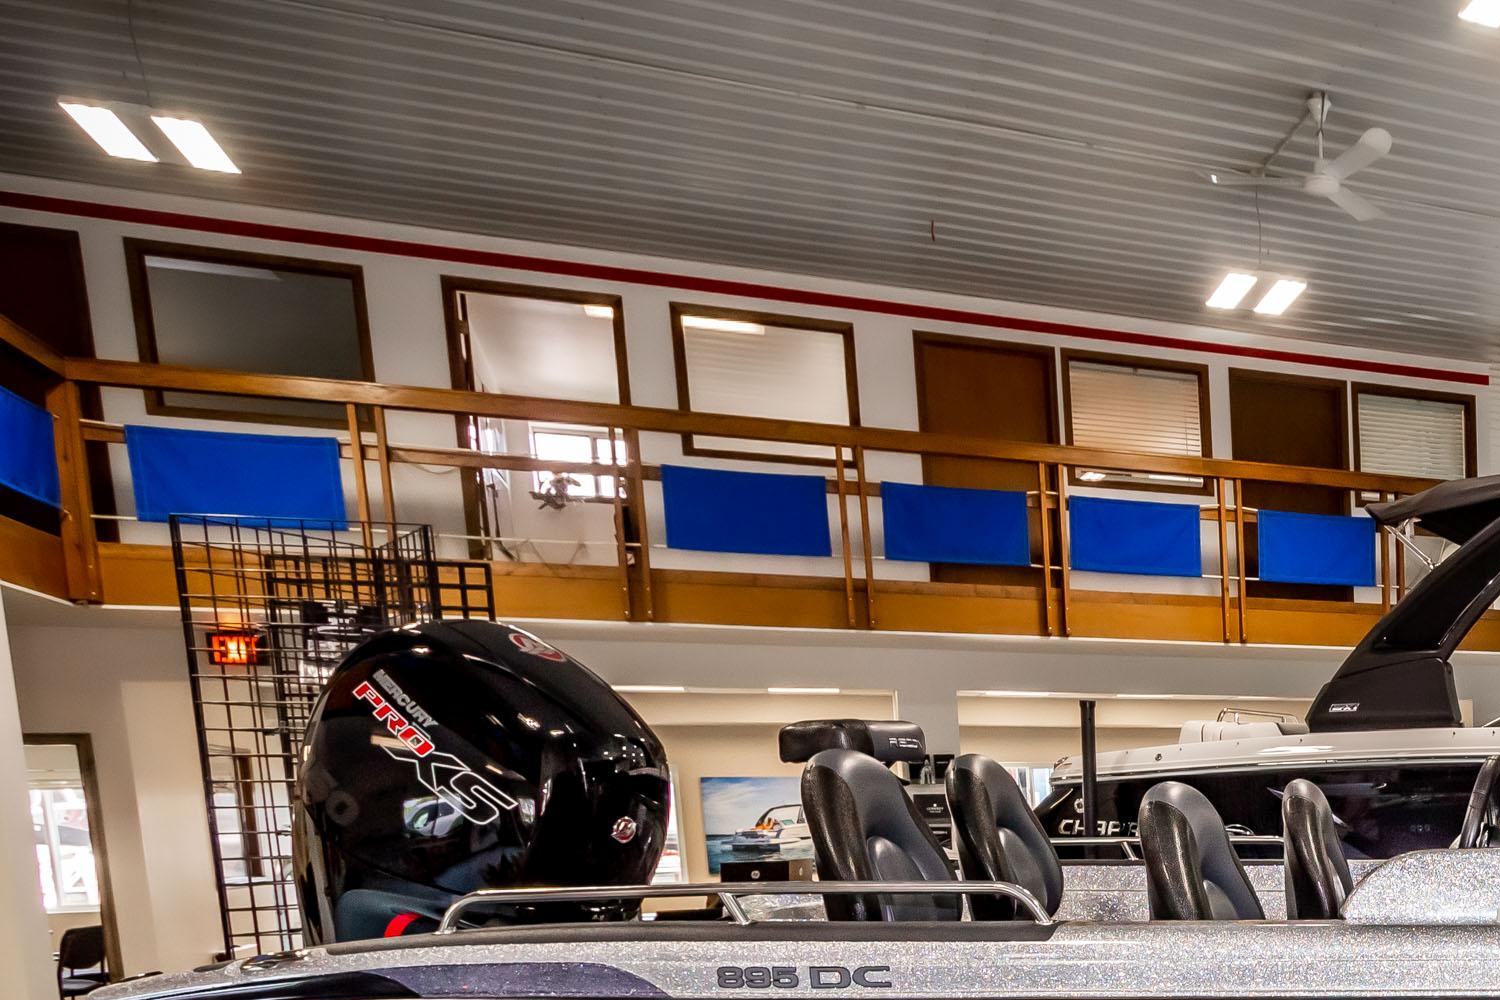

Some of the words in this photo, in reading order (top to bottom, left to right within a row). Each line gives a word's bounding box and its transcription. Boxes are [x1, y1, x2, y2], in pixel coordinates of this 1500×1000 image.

[353, 681, 435, 757] PRO
[372, 668, 439, 727] MERCURY
[380, 744, 518, 825] XS
[717, 966, 799, 988] 895
[809, 966, 892, 989] DC
